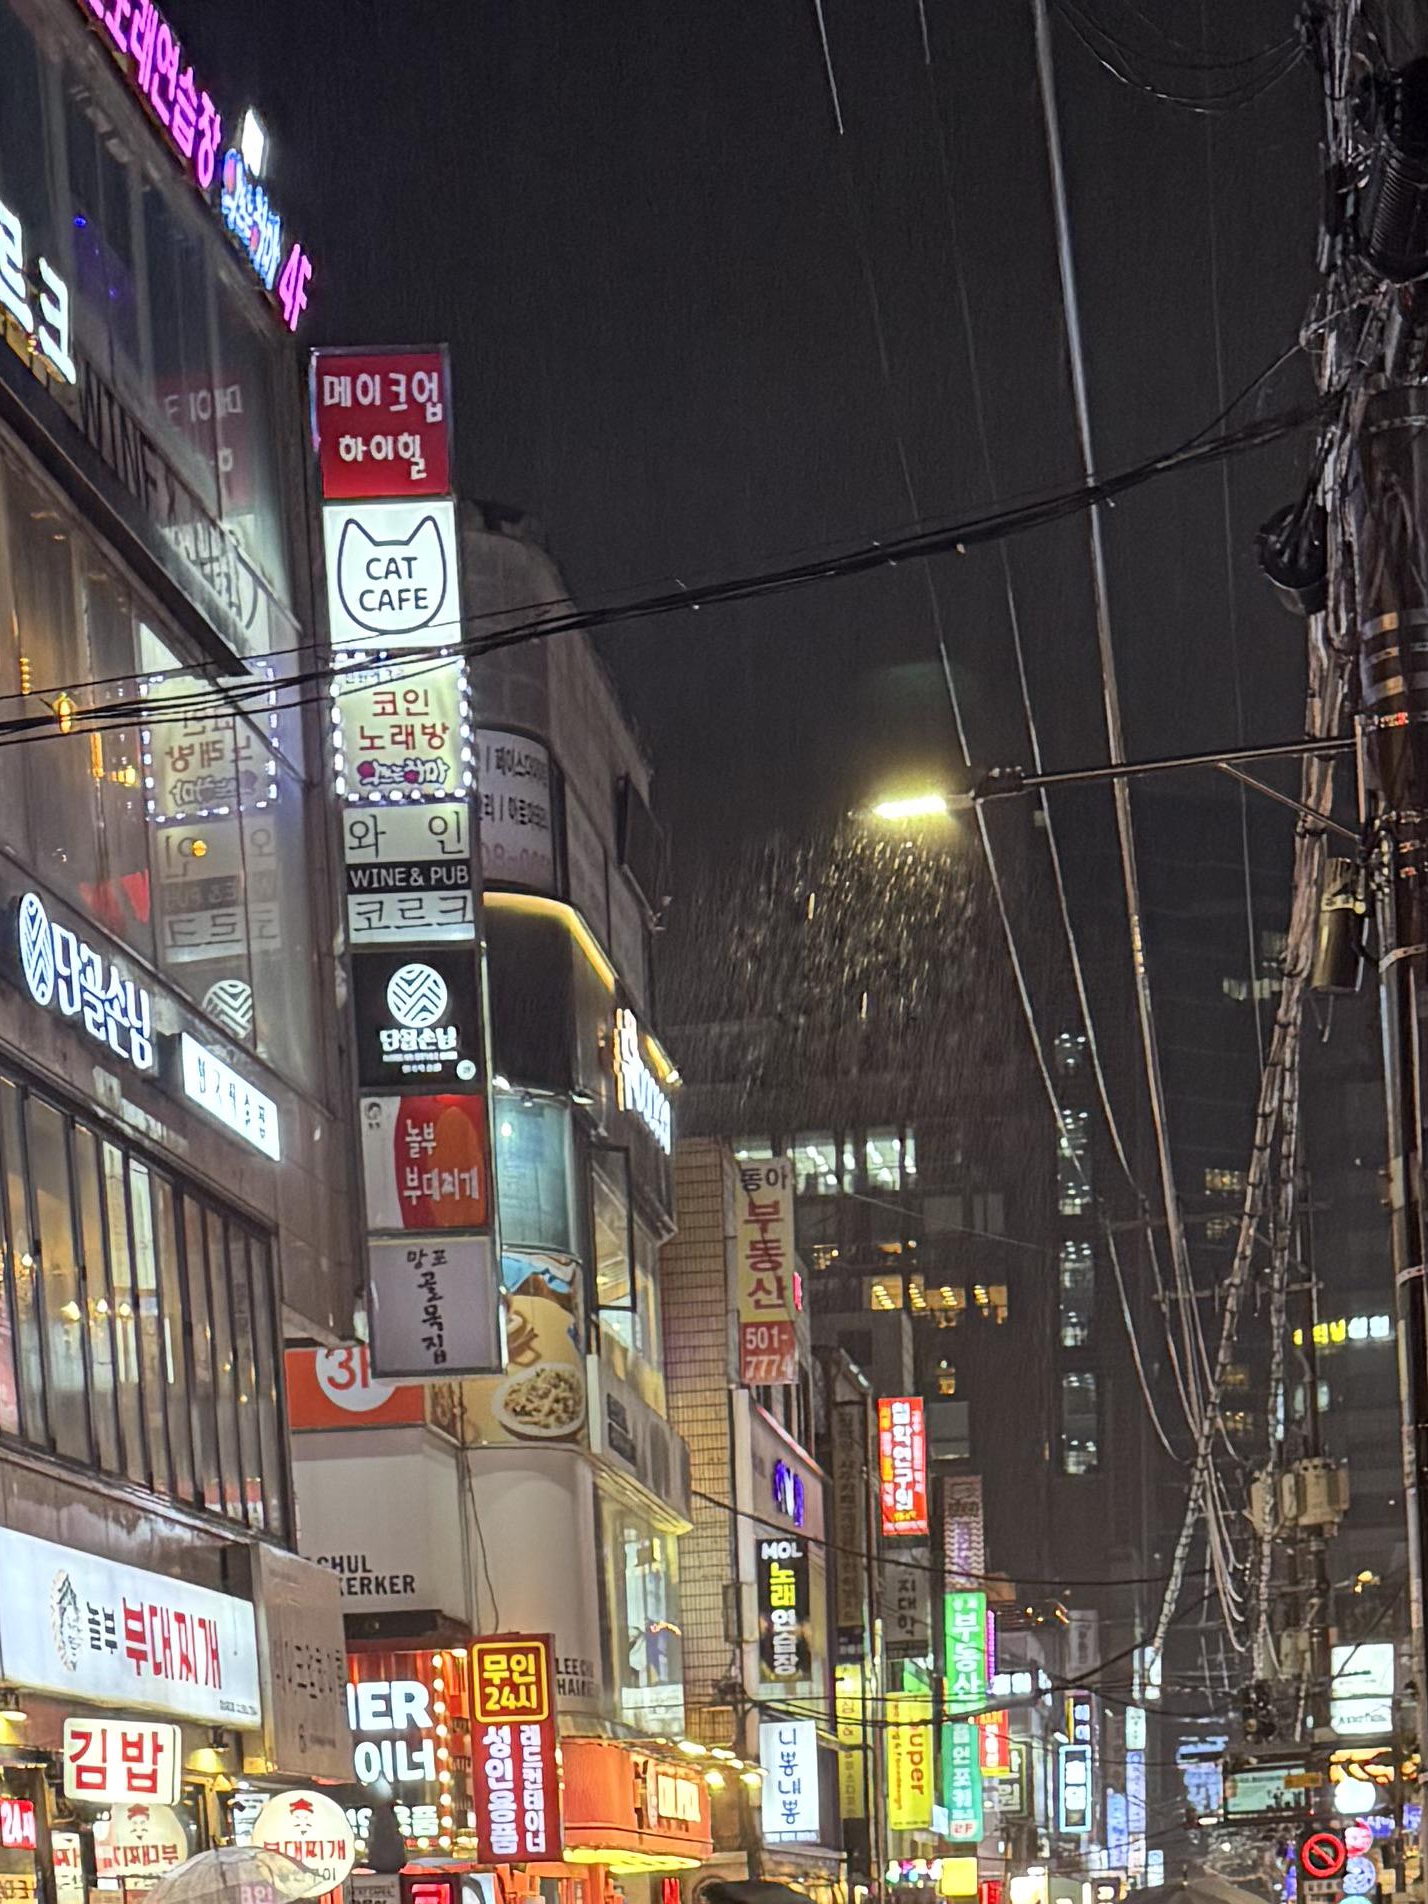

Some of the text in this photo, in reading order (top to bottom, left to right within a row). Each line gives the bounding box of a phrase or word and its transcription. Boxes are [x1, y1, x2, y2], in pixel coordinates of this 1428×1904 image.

[278, 243, 312, 332] 4F
[323, 371, 444, 423] 메이크업
[339, 431, 428, 480] 하이힐
[366, 556, 419, 582] CAT
[358, 587, 429, 612] CAFE
[372, 688, 430, 717] 코인
[358, 722, 450, 751] 노래방
[351, 866, 469, 888] WINE & PUB
[352, 895, 474, 935] 코르크
[52, 921, 154, 1071] 단골손님
[405, 1118, 438, 1158] 놀부
[402, 1166, 480, 1207] 부대찌개
[740, 1166, 789, 1192] 동아
[406, 1247, 449, 1268] 망포
[743, 1202, 789, 1311] 부동산
[416, 1270, 448, 1367] 골목집
[745, 1327, 789, 1350] 501-
[744, 1355, 793, 1380] 7774
[760, 1540, 803, 1560] MOL
[87, 1600, 118, 1656] 놀부
[122, 1596, 222, 1691] 부대찌개
[482, 1653, 537, 1686] 무인
[483, 1684, 538, 1712] 24시
[69, 1728, 164, 1795] 김밥
[777, 1727, 801, 1825] 니뽕내뽕
[905, 1722, 925, 1796] uper
[482, 1725, 520, 1856] 성인용품
